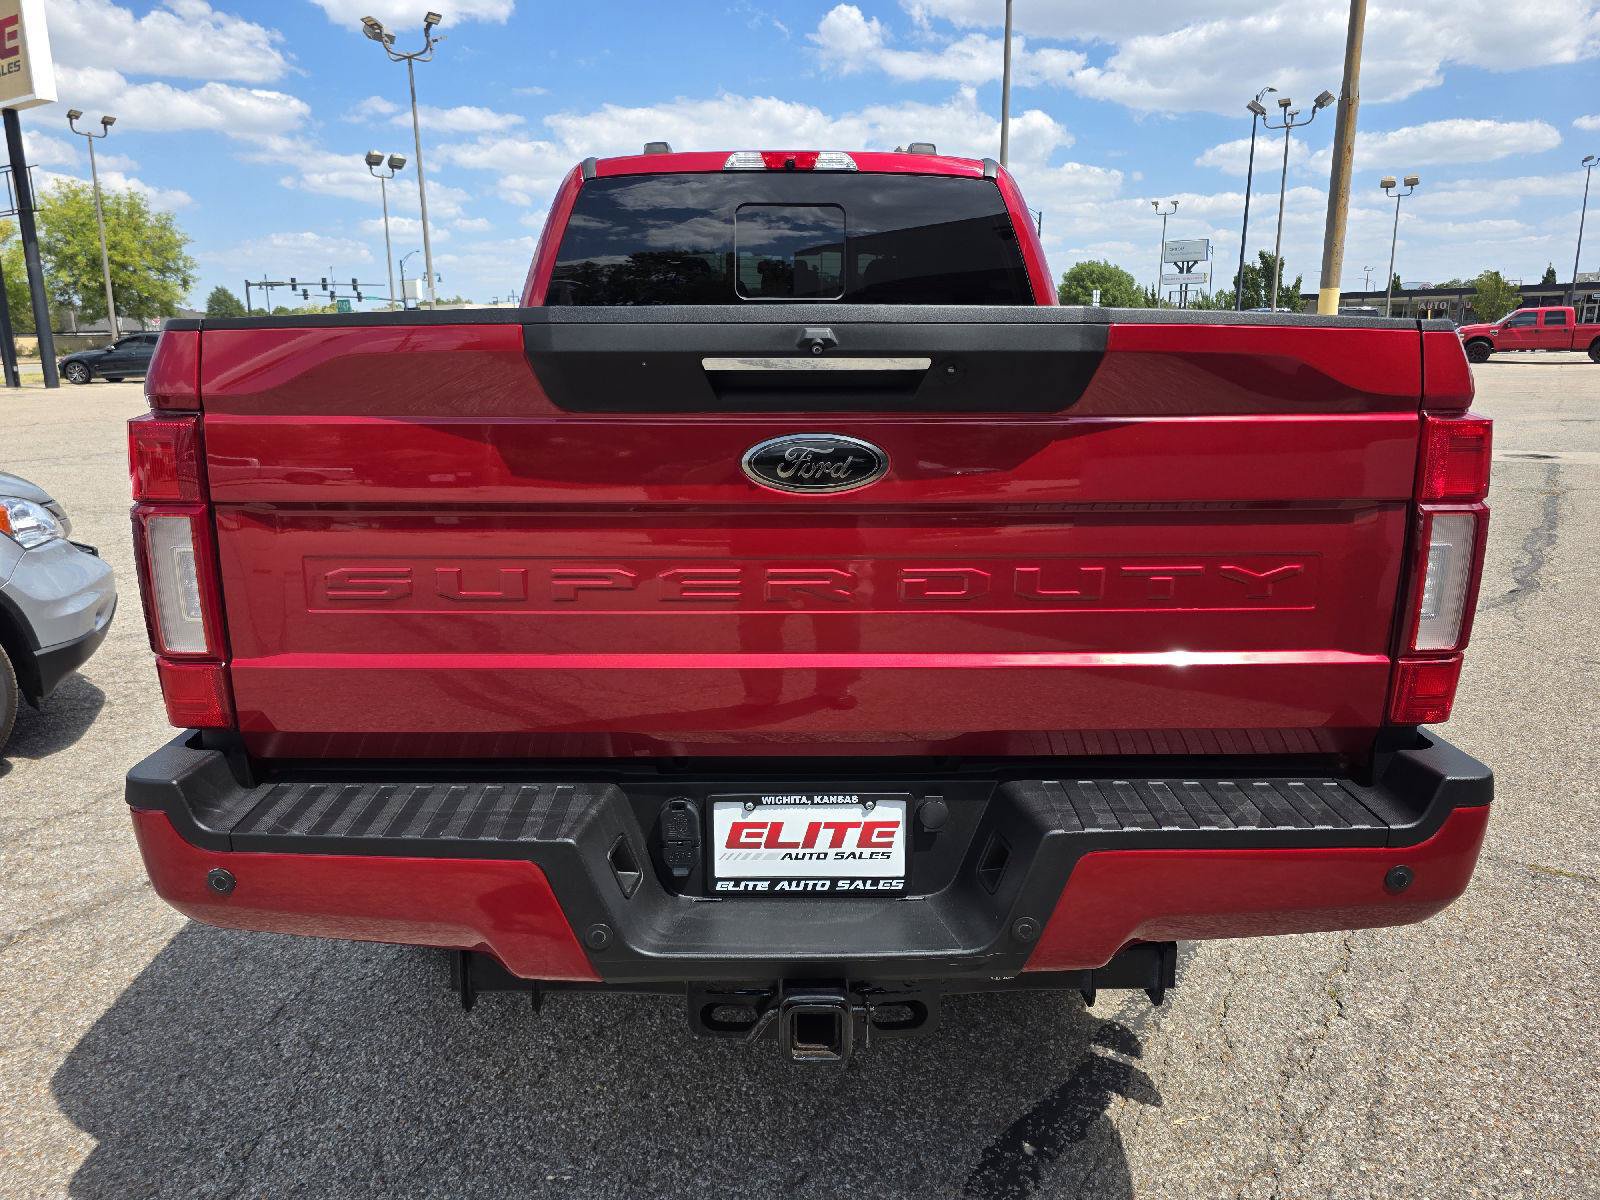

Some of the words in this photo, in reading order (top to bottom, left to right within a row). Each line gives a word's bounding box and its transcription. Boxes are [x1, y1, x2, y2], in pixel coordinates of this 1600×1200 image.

[0, 60, 21, 77] LES
[1418, 301, 1447, 310] AUTO
[776, 446, 853, 478] Ford
[325, 566, 857, 601] SUPER
[896, 565, 1305, 602] DUTY
[761, 796, 812, 805] WICHITA,
[813, 795, 859, 804] KANSAS
[725, 821, 900, 849] ELITE
[780, 851, 828, 860] AUTO
[833, 851, 892, 860] SALES
[715, 880, 771, 890] ELITE
[774, 880, 831, 890] AUTO
[835, 879, 905, 890] SALES
